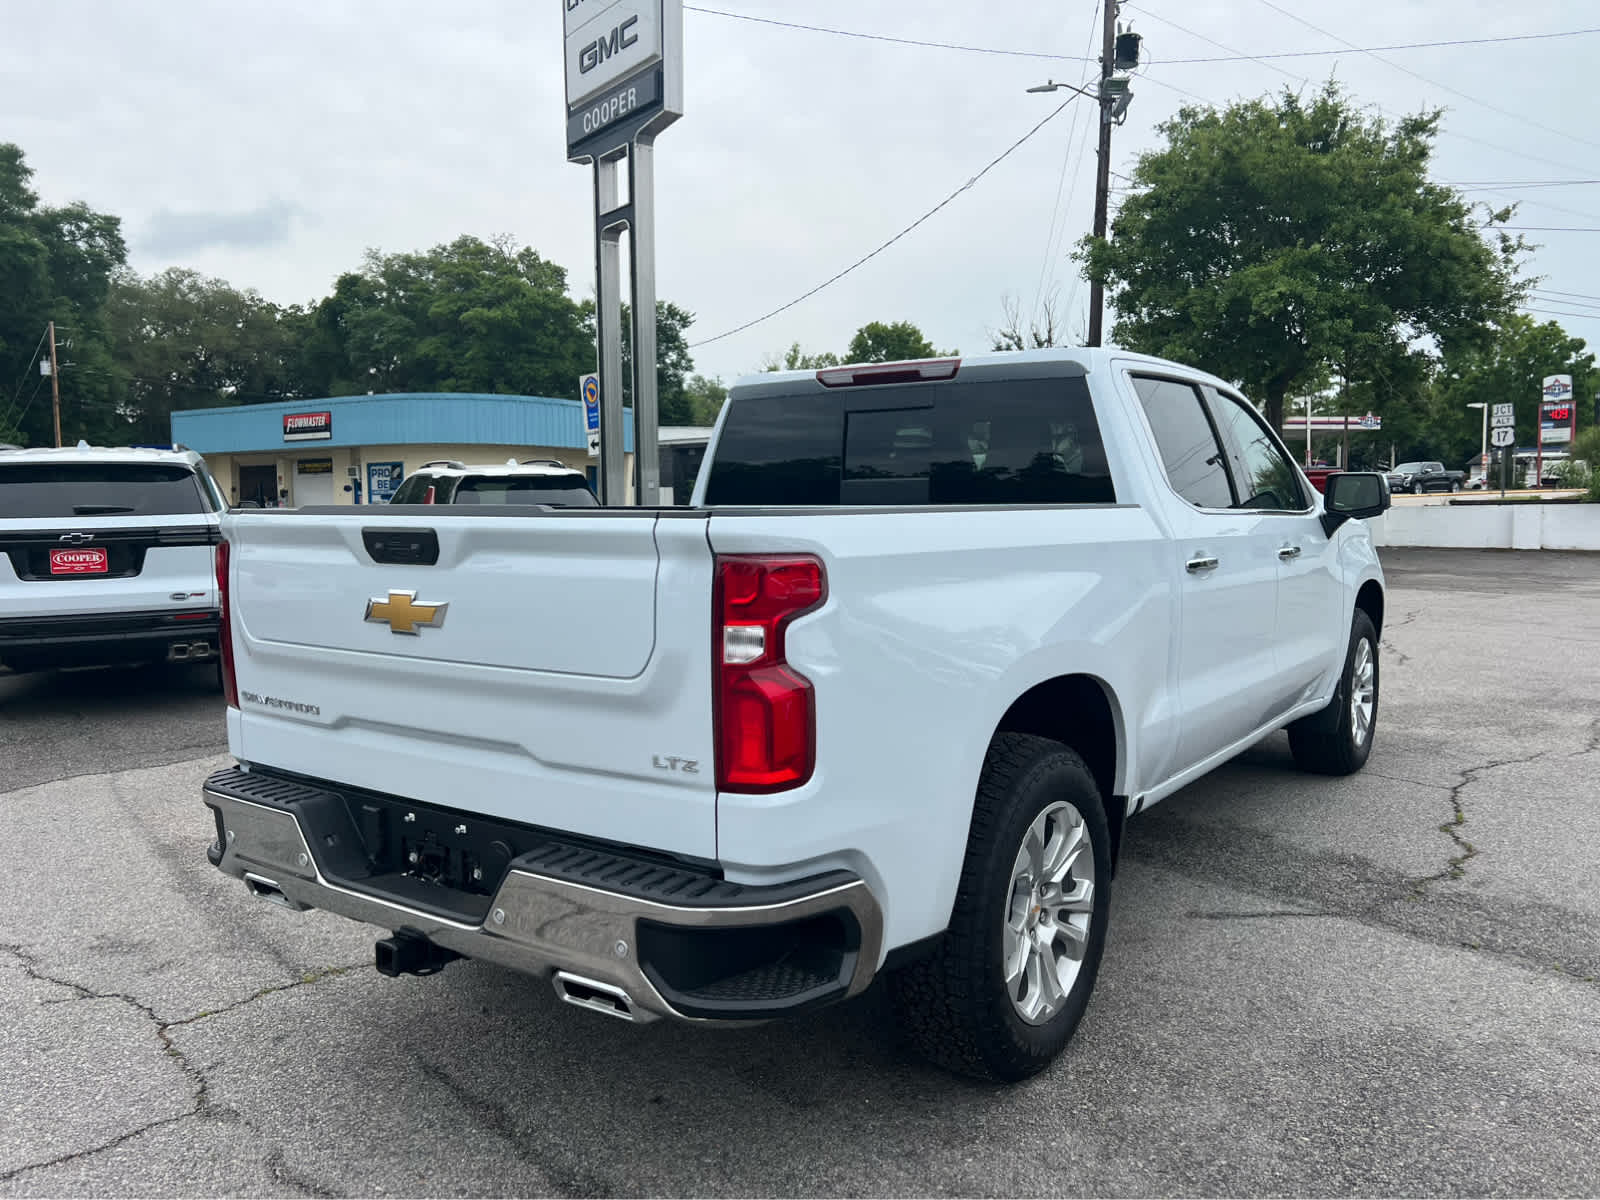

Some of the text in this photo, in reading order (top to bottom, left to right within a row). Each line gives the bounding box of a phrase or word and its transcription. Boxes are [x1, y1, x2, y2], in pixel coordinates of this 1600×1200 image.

[579, 14, 638, 75] GMC
[583, 87, 637, 134] COOPER
[1494, 404, 1513, 415] JCT
[286, 415, 326, 433] FLOWMASTER
[1496, 417, 1511, 425] ALT
[1497, 430, 1509, 443] 17
[56, 554, 100, 563] COOPER
[652, 754, 700, 774] LTZ
